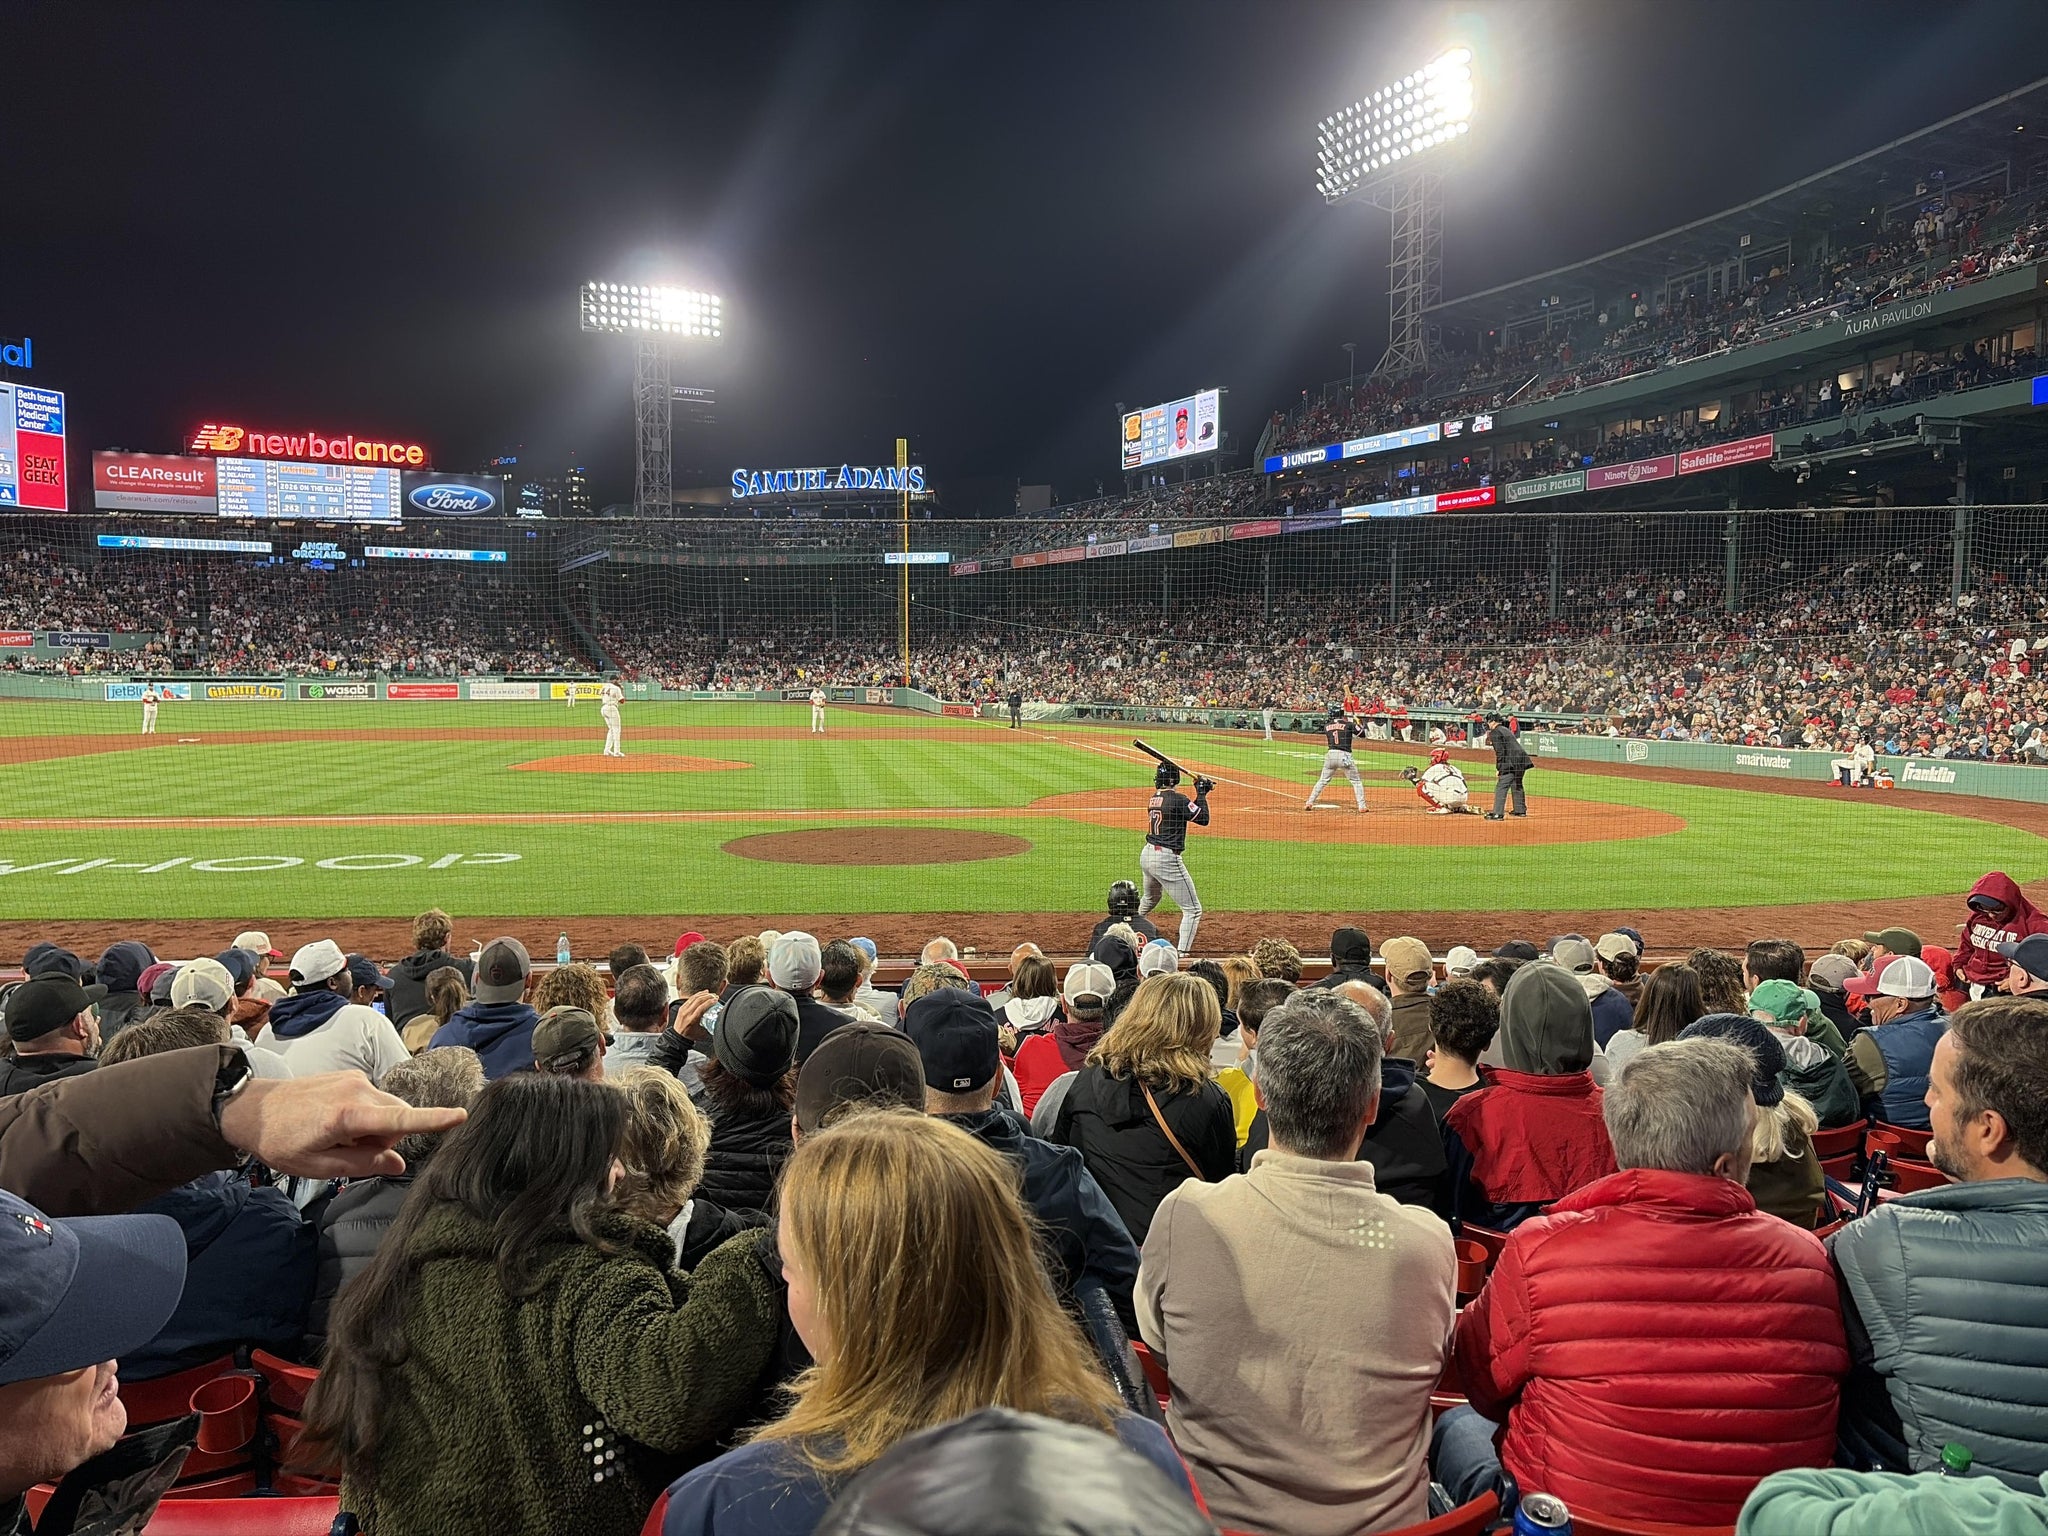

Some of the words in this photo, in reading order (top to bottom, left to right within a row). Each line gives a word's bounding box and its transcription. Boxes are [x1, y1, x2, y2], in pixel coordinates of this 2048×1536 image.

[1882, 302, 1932, 325] PAVILION
[0, 338, 32, 368] al
[18, 390, 36, 401] Beth
[37, 392, 58, 404] Israel
[18, 400, 60, 414] Deaconess
[19, 410, 49, 421] Medical
[19, 418, 45, 430] Center
[1364, 440, 1380, 450] BREAK
[25, 455, 57, 471] SEAT
[1292, 449, 1326, 465] UNITED
[1682, 452, 1724, 469] Safelite
[24, 470, 59, 485] GEEK
[106, 466, 204, 483] CLEAResult
[732, 468, 827, 498] SAMUEL
[835, 464, 925, 492] ADAMS
[1605, 470, 1627, 481] Ninety
[1641, 466, 1658, 474] Nine
[1517, 483, 1547, 496] GRILLO'S
[1550, 477, 1581, 491] PICKLES
[116, 495, 197, 504] clearesult.com/redsox
[426, 488, 477, 510] Ford
[301, 542, 338, 551] ANGRY
[292, 550, 346, 560] ORCHARD
[2, 635, 32, 644] TICKET
[112, 685, 143, 698] jetBlu
[208, 685, 256, 697] GRANITE
[258, 685, 283, 698] CITY
[325, 685, 368, 694] wasabi
[1736, 754, 1791, 769] smartwater
[1902, 762, 1956, 784] franklin
[1973, 924, 2005, 941] UNIVERITY
[2006, 933, 2017, 942] OF
